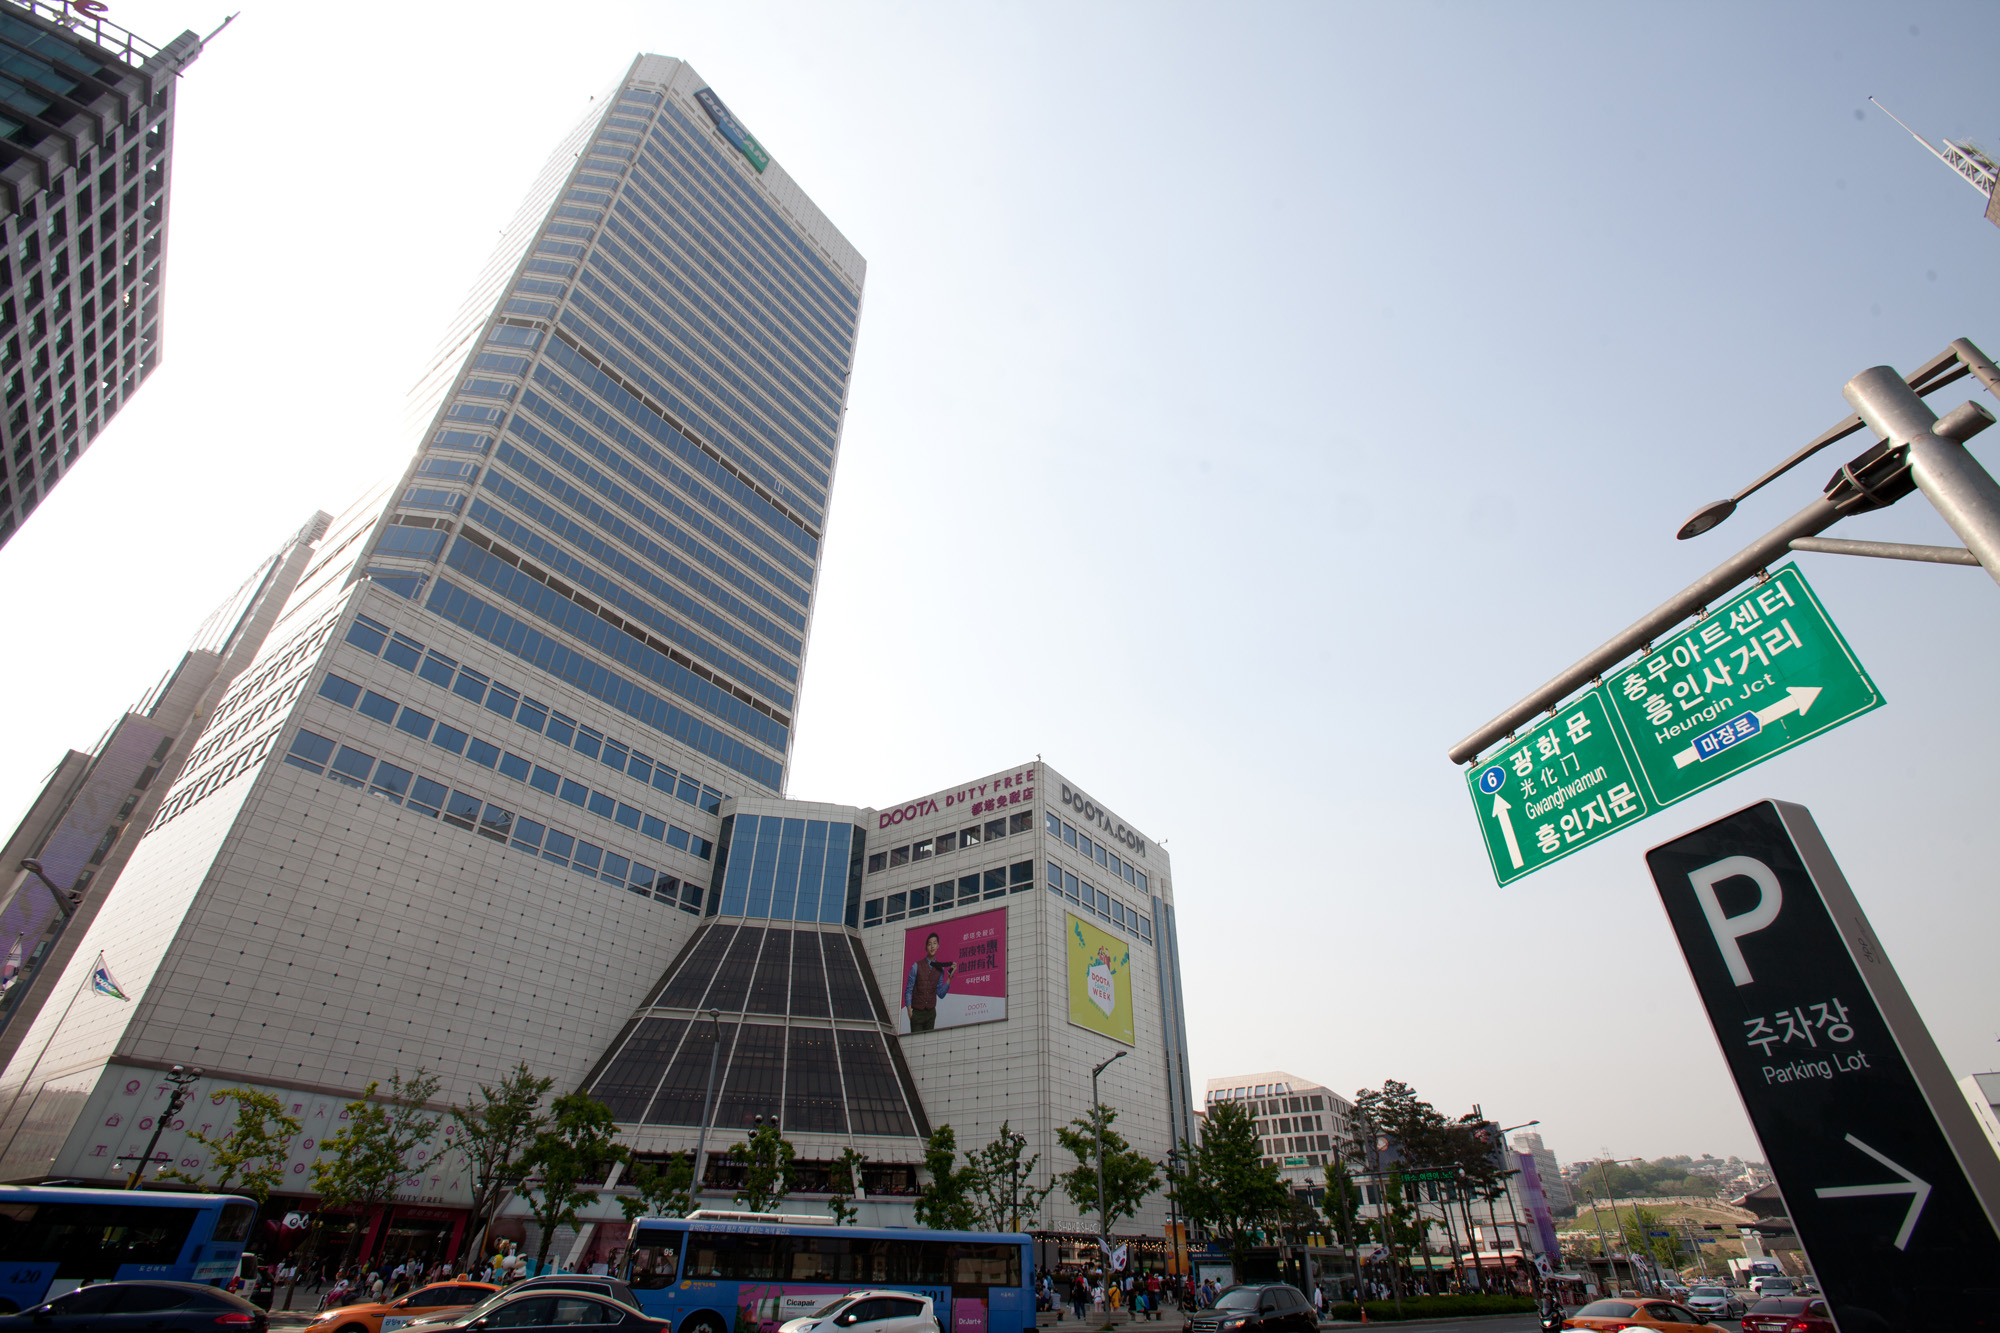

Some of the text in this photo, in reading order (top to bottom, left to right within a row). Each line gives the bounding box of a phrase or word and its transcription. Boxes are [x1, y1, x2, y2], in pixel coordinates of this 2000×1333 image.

[700, 92, 767, 163] DOOSAN
[1621, 580, 1796, 702] 충무아트센터
[1642, 618, 1803, 727] 흥인사거리
[1654, 672, 1776, 744] Heungin Jct
[1700, 717, 1756, 753] 마장로
[879, 769, 1035, 829] DOOTA DUTY FREE
[1486, 771, 1498, 788] 6
[1525, 764, 1608, 820] Gwanghwamun
[1062, 783, 1146, 858] DOOTA.COM
[1535, 781, 1638, 855] 흥인지문
[1687, 855, 1783, 987] P
[1091, 972, 1111, 987] DOOTA
[1092, 987, 1111, 1001] WEEK
[1742, 997, 1854, 1058] 주차장
[1762, 1049, 1871, 1085] Parking Lot
[421, 1195, 445, 1204] FREE
[9, 1268, 41, 1285] 420
[663, 1248, 674, 1257] 95
[786, 1298, 815, 1307] Cicapair
